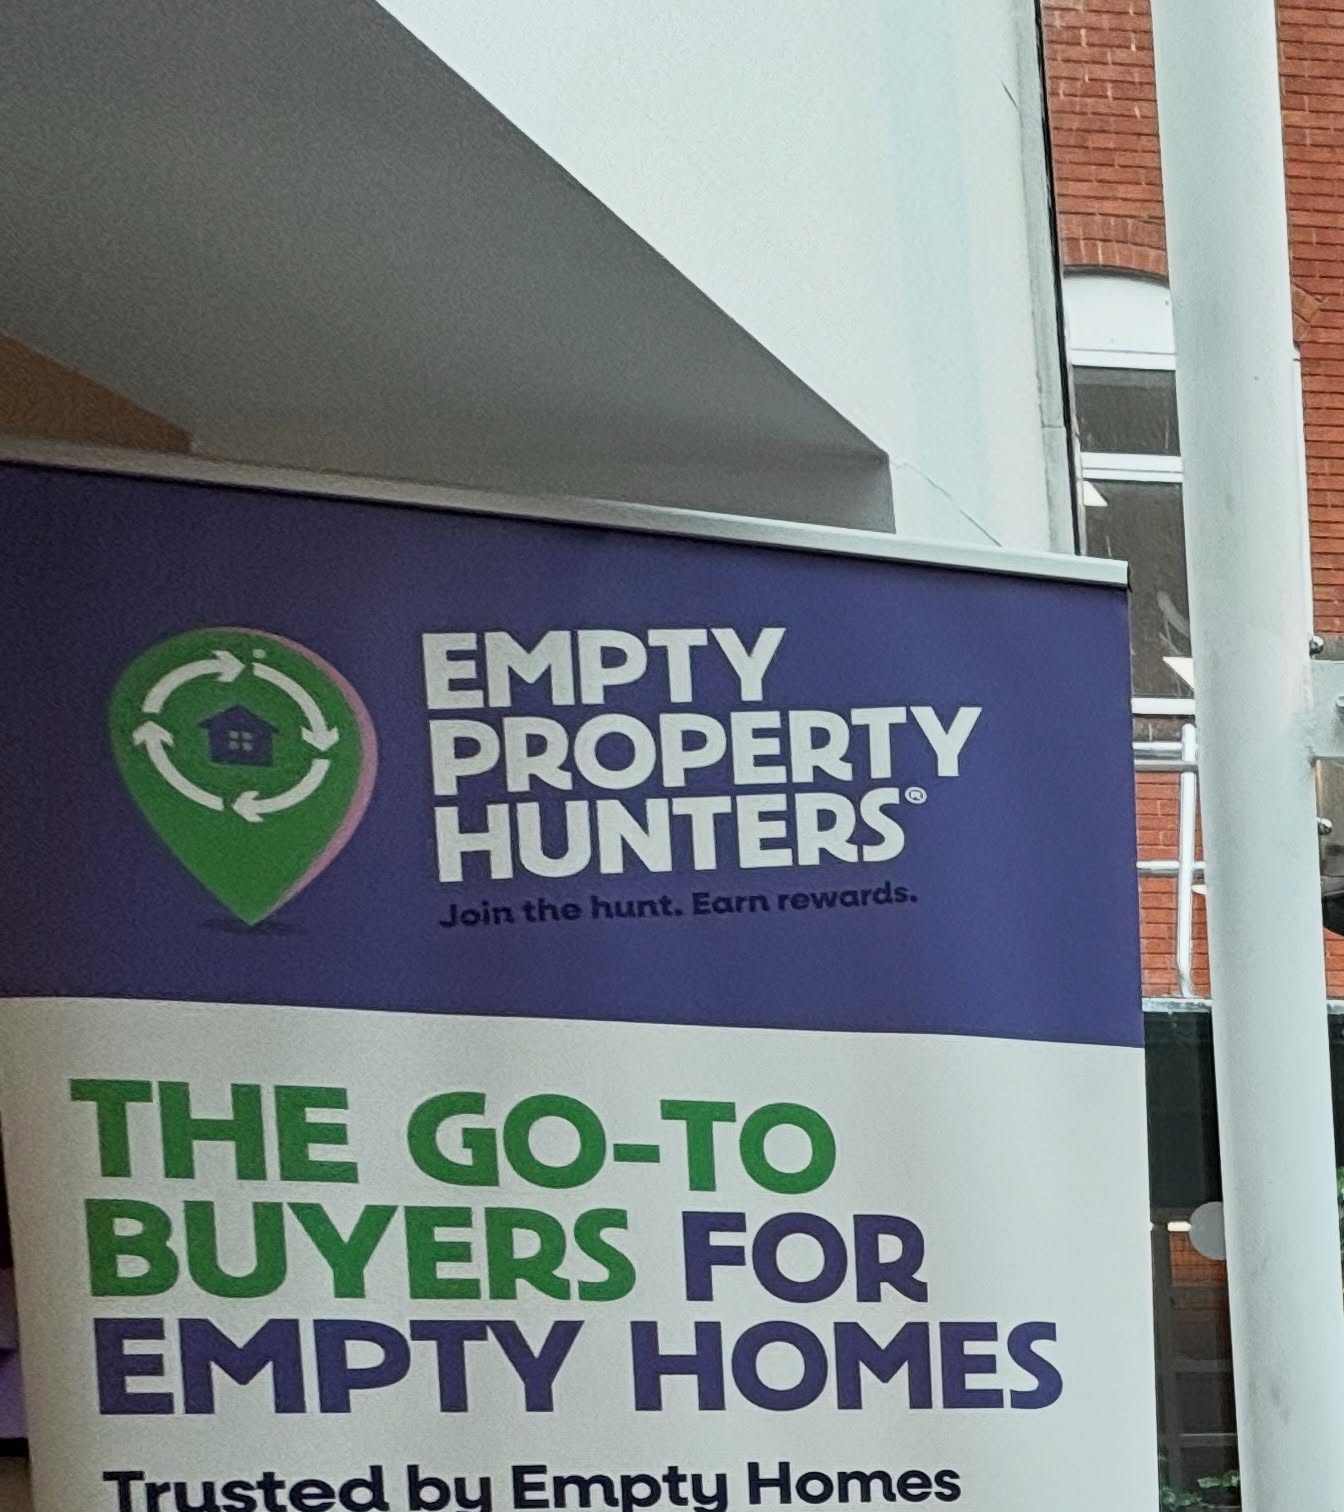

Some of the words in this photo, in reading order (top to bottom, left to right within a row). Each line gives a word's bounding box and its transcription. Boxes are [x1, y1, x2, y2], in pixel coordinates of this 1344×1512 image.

[423, 628, 786, 709] EMPTY
[430, 706, 982, 795] PROPERTY
[438, 900, 516, 928] Join
[521, 898, 582, 922] the
[591, 895, 683, 919] hunt.
[692, 892, 770, 915] Earn
[778, 881, 917, 910] rewards.
[67, 1078, 359, 1183] THE
[407, 1092, 836, 1194] GO-TO
[83, 1198, 636, 1301] BUYERS
[682, 1211, 928, 1303] FOR
[93, 1317, 584, 1415] EMPTY
[630, 1321, 1062, 1411] HOMES
[748, 1462, 961, 1504] Homes
